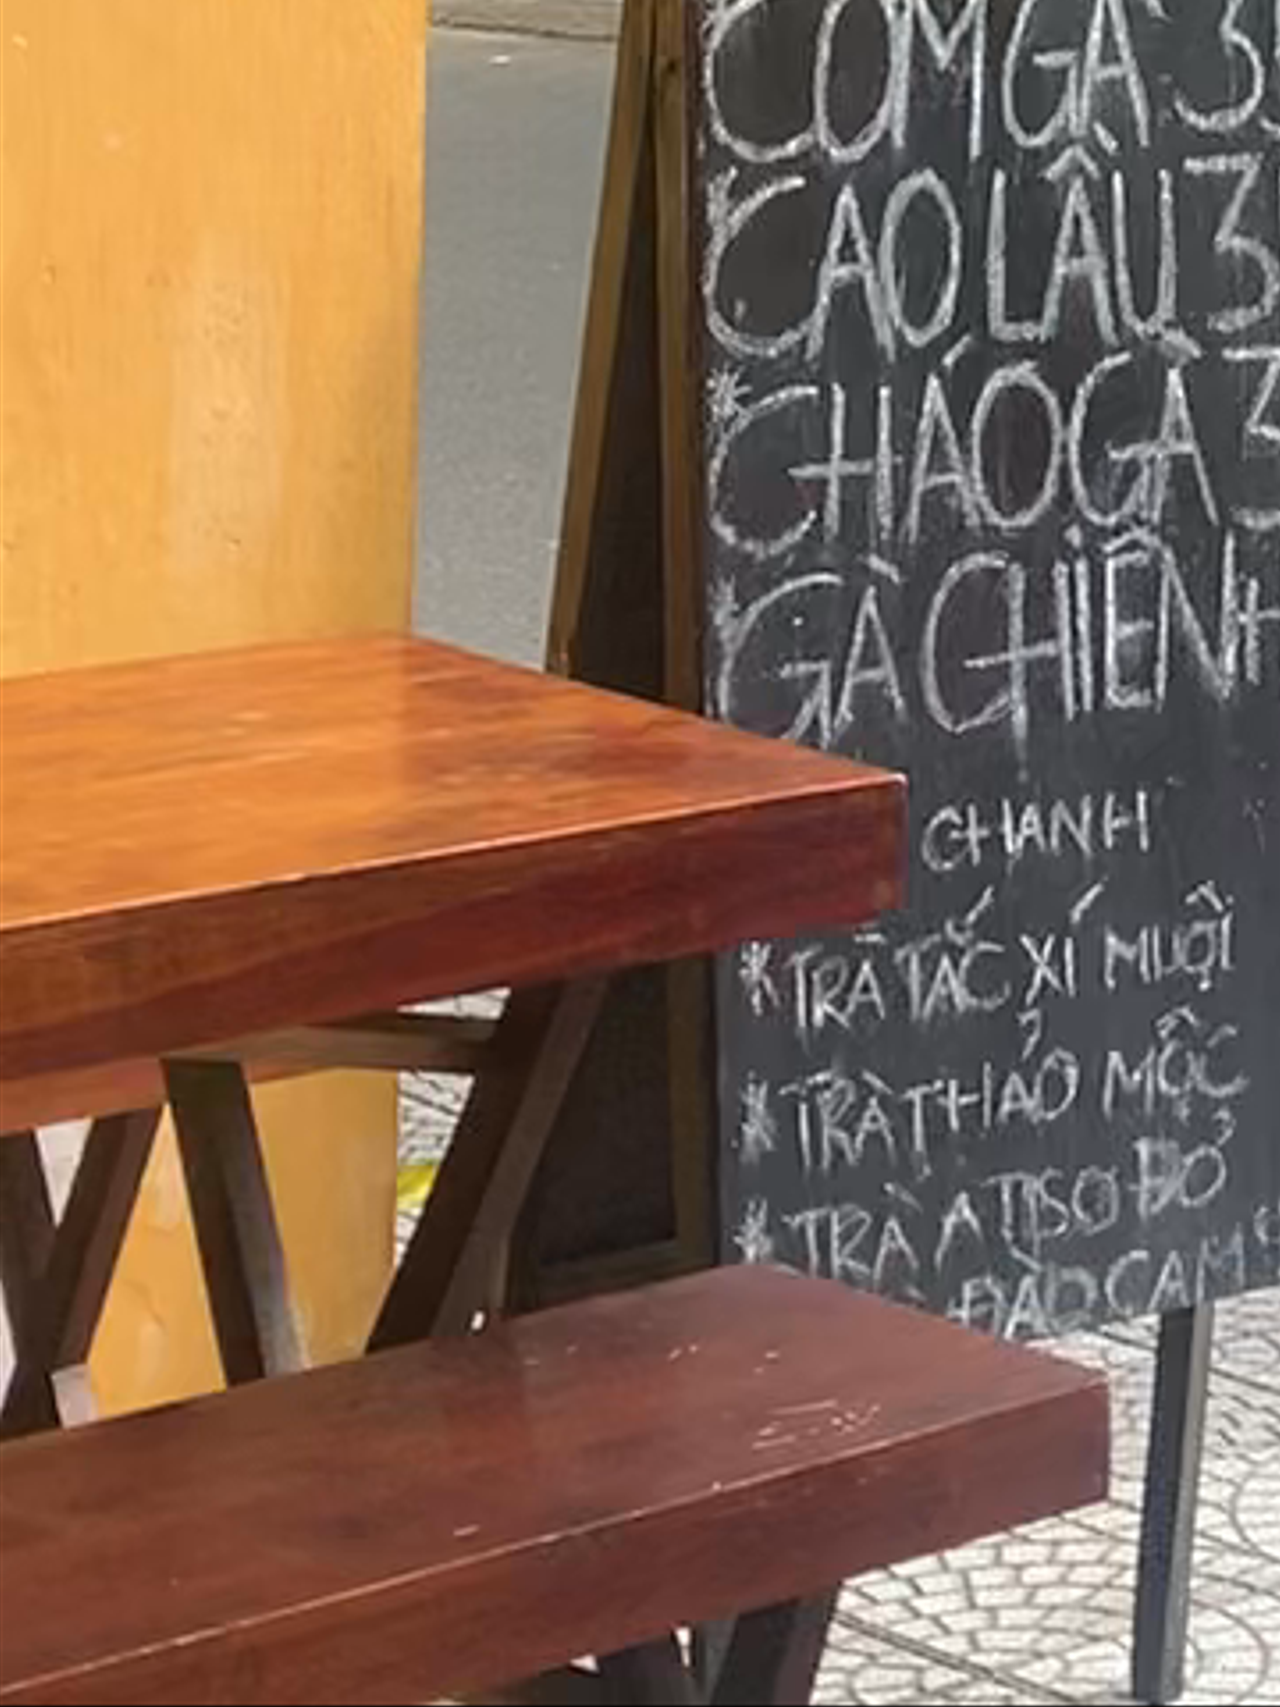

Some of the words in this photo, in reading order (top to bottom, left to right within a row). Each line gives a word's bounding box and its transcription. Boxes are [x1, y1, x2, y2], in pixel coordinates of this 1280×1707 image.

[704, 168, 961, 363] CAO
[709, 334, 1064, 560] CHÁO
[921, 789, 1150, 876] CHANH
[894, 884, 1009, 1023] TẮC
[1017, 878, 1106, 1006] XÍ
[778, 1068, 898, 1172] TRÀ
[903, 1006, 1077, 1164] THẢO
[1102, 1004, 1249, 1124] MỘC
